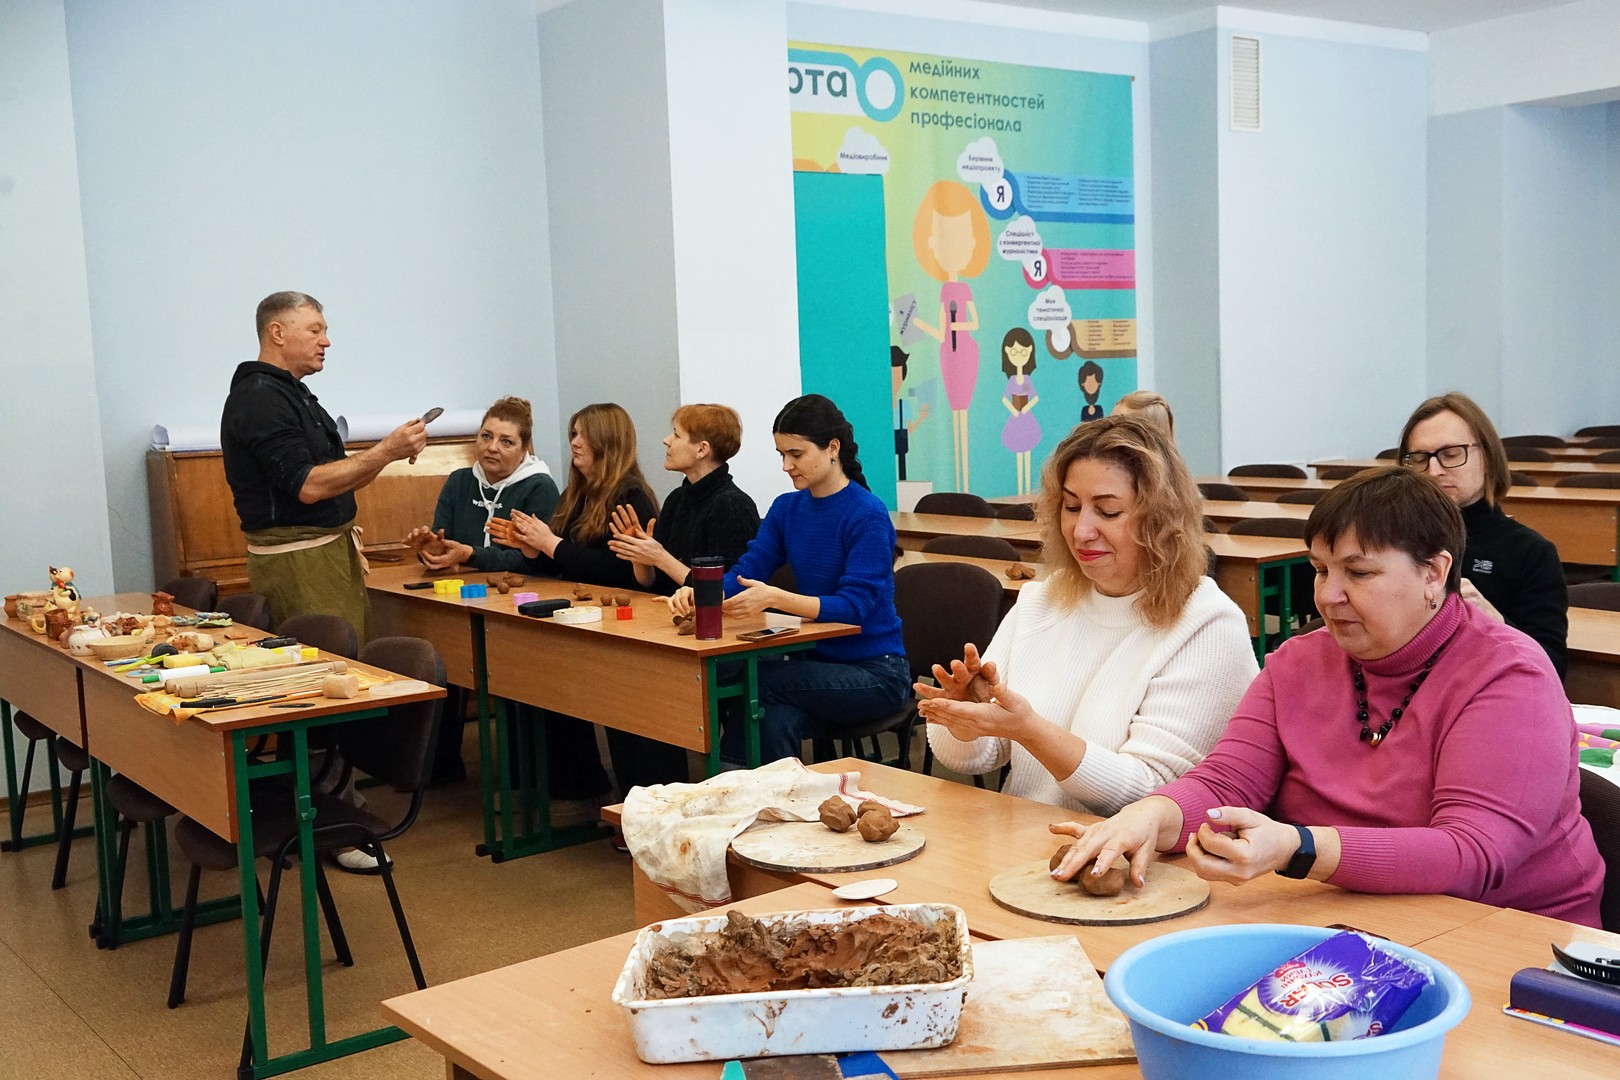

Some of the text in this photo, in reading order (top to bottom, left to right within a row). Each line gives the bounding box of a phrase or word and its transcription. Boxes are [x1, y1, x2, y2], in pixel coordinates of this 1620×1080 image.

[909, 60, 980, 80] медійних
[910, 86, 1045, 110] компетентностей
[911, 110, 1022, 132] професіонала
[996, 185, 1005, 203] Я
[1034, 260, 1042, 277] Я
